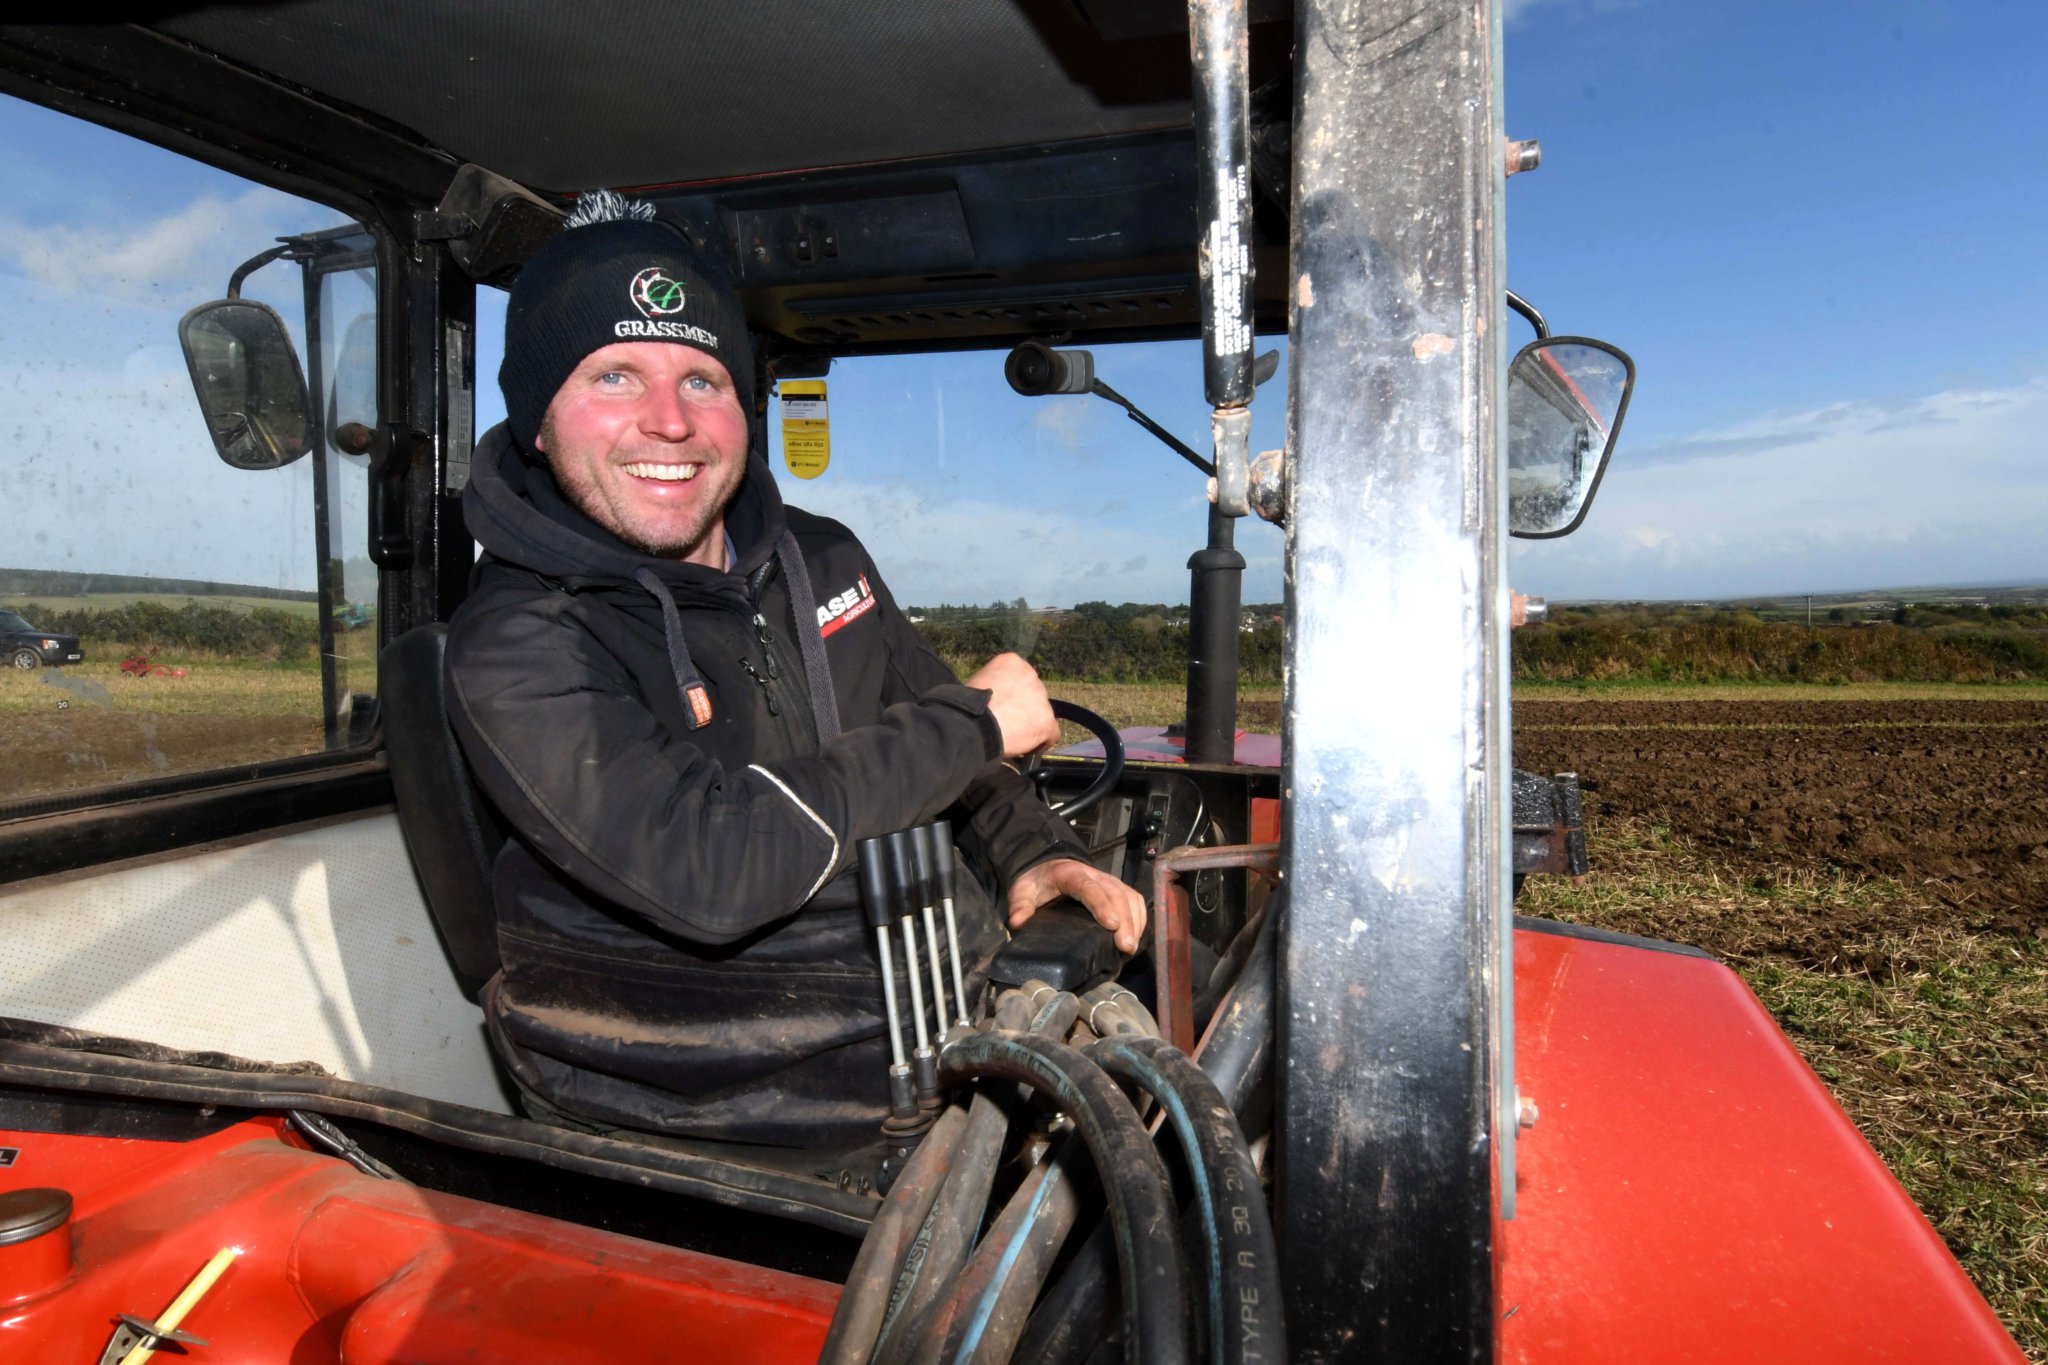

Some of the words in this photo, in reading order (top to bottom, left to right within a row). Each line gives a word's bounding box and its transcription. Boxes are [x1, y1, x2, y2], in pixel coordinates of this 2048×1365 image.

[614, 320, 718, 349] GRASSMEN
[817, 586, 860, 627] ASE
[1240, 1286, 1262, 1364] TYPE
